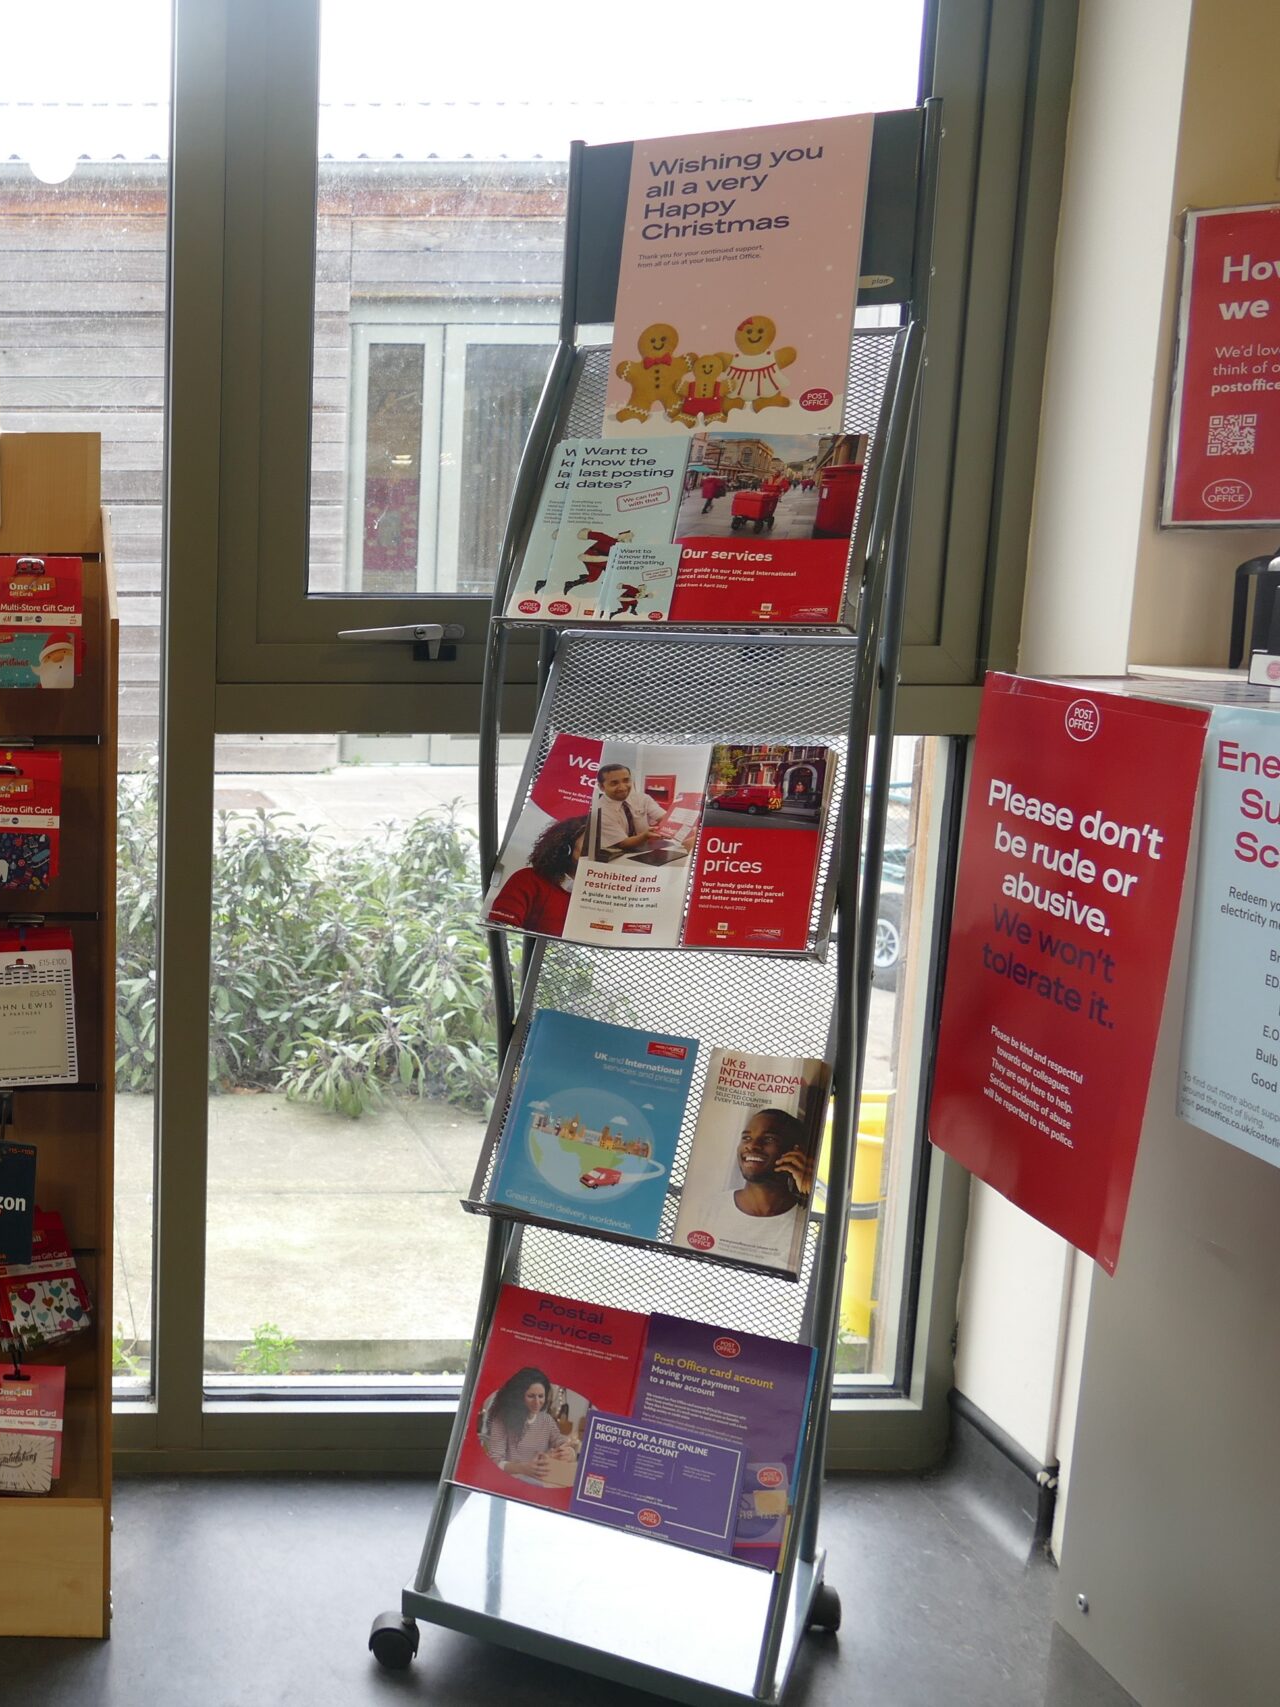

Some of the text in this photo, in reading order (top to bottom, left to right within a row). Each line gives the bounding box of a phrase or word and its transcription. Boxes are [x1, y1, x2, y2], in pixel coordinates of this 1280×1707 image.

[649, 146, 823, 176] Wishing you
[646, 174, 768, 198] all a very
[644, 199, 736, 220] Happy
[642, 214, 789, 240] Christmas
[1219, 300, 1269, 320] we
[1213, 362, 1269, 375] think of
[802, 398, 829, 406] OFFICE
[807, 392, 827, 400] POST
[581, 458, 656, 466] know the
[579, 469, 674, 478] last posting
[576, 480, 631, 488] dates?
[1215, 486, 1241, 494] POST
[1208, 494, 1244, 502] OFFICE
[682, 549, 772, 562] Our services
[1, 604, 40, 612] Multi-Store
[43, 604, 56, 612] Gift
[1074, 708, 1093, 720] POST
[1069, 718, 1093, 731] OFFICE
[20, 805, 33, 813] Gift
[35, 806, 53, 814] Card
[987, 779, 1164, 860] Please don't
[707, 838, 742, 854] Our
[703, 857, 762, 875] prices
[995, 822, 1138, 897] be rude or
[587, 869, 657, 883] Prohibited and
[585, 881, 661, 893] restricted items
[1002, 873, 1110, 937] abusive.
[1229, 886, 1267, 911] Redeem
[1221, 904, 1267, 927] electricity
[993, 903, 1115, 983] We won't
[982, 945, 1114, 1029] tolerate it.
[22, 1002, 54, 1010] LEWIS
[595, 1052, 682, 1075] UK and International
[723, 1057, 746, 1068] UK &
[991, 1025, 1083, 1084] Please be kind and respectful
[1256, 1049, 1278, 1067] Bulb
[603, 1064, 680, 1084] services and prices
[997, 1046, 1071, 1095] towards our colleagues.
[718, 1077, 795, 1094] PHONE CARDS
[1251, 1073, 1277, 1093] Good
[989, 1073, 1071, 1129] Serious incidents of abuse
[1239, 1098, 1259, 1113] about
[1219, 1102, 1264, 1129] cost of living.
[506, 1190, 527, 1203] Great
[530, 1193, 554, 1210] British
[690, 1237, 711, 1247] OFFICE
[539, 1300, 604, 1324] Postal
[522, 1314, 612, 1345] Services
[716, 1345, 736, 1354] OFFICE
[651, 1365, 740, 1393] Moving your payments
[654, 1353, 774, 1389] Post Office card account
[665, 1380, 682, 1388] new
[684, 1383, 715, 1397] account
[594, 1433, 617, 1444] DROP
[623, 1439, 636, 1448] GO
[637, 1443, 679, 1459] ACCOUNT
[596, 1423, 708, 1456] REGISTER FOR A FREE ONLINE
